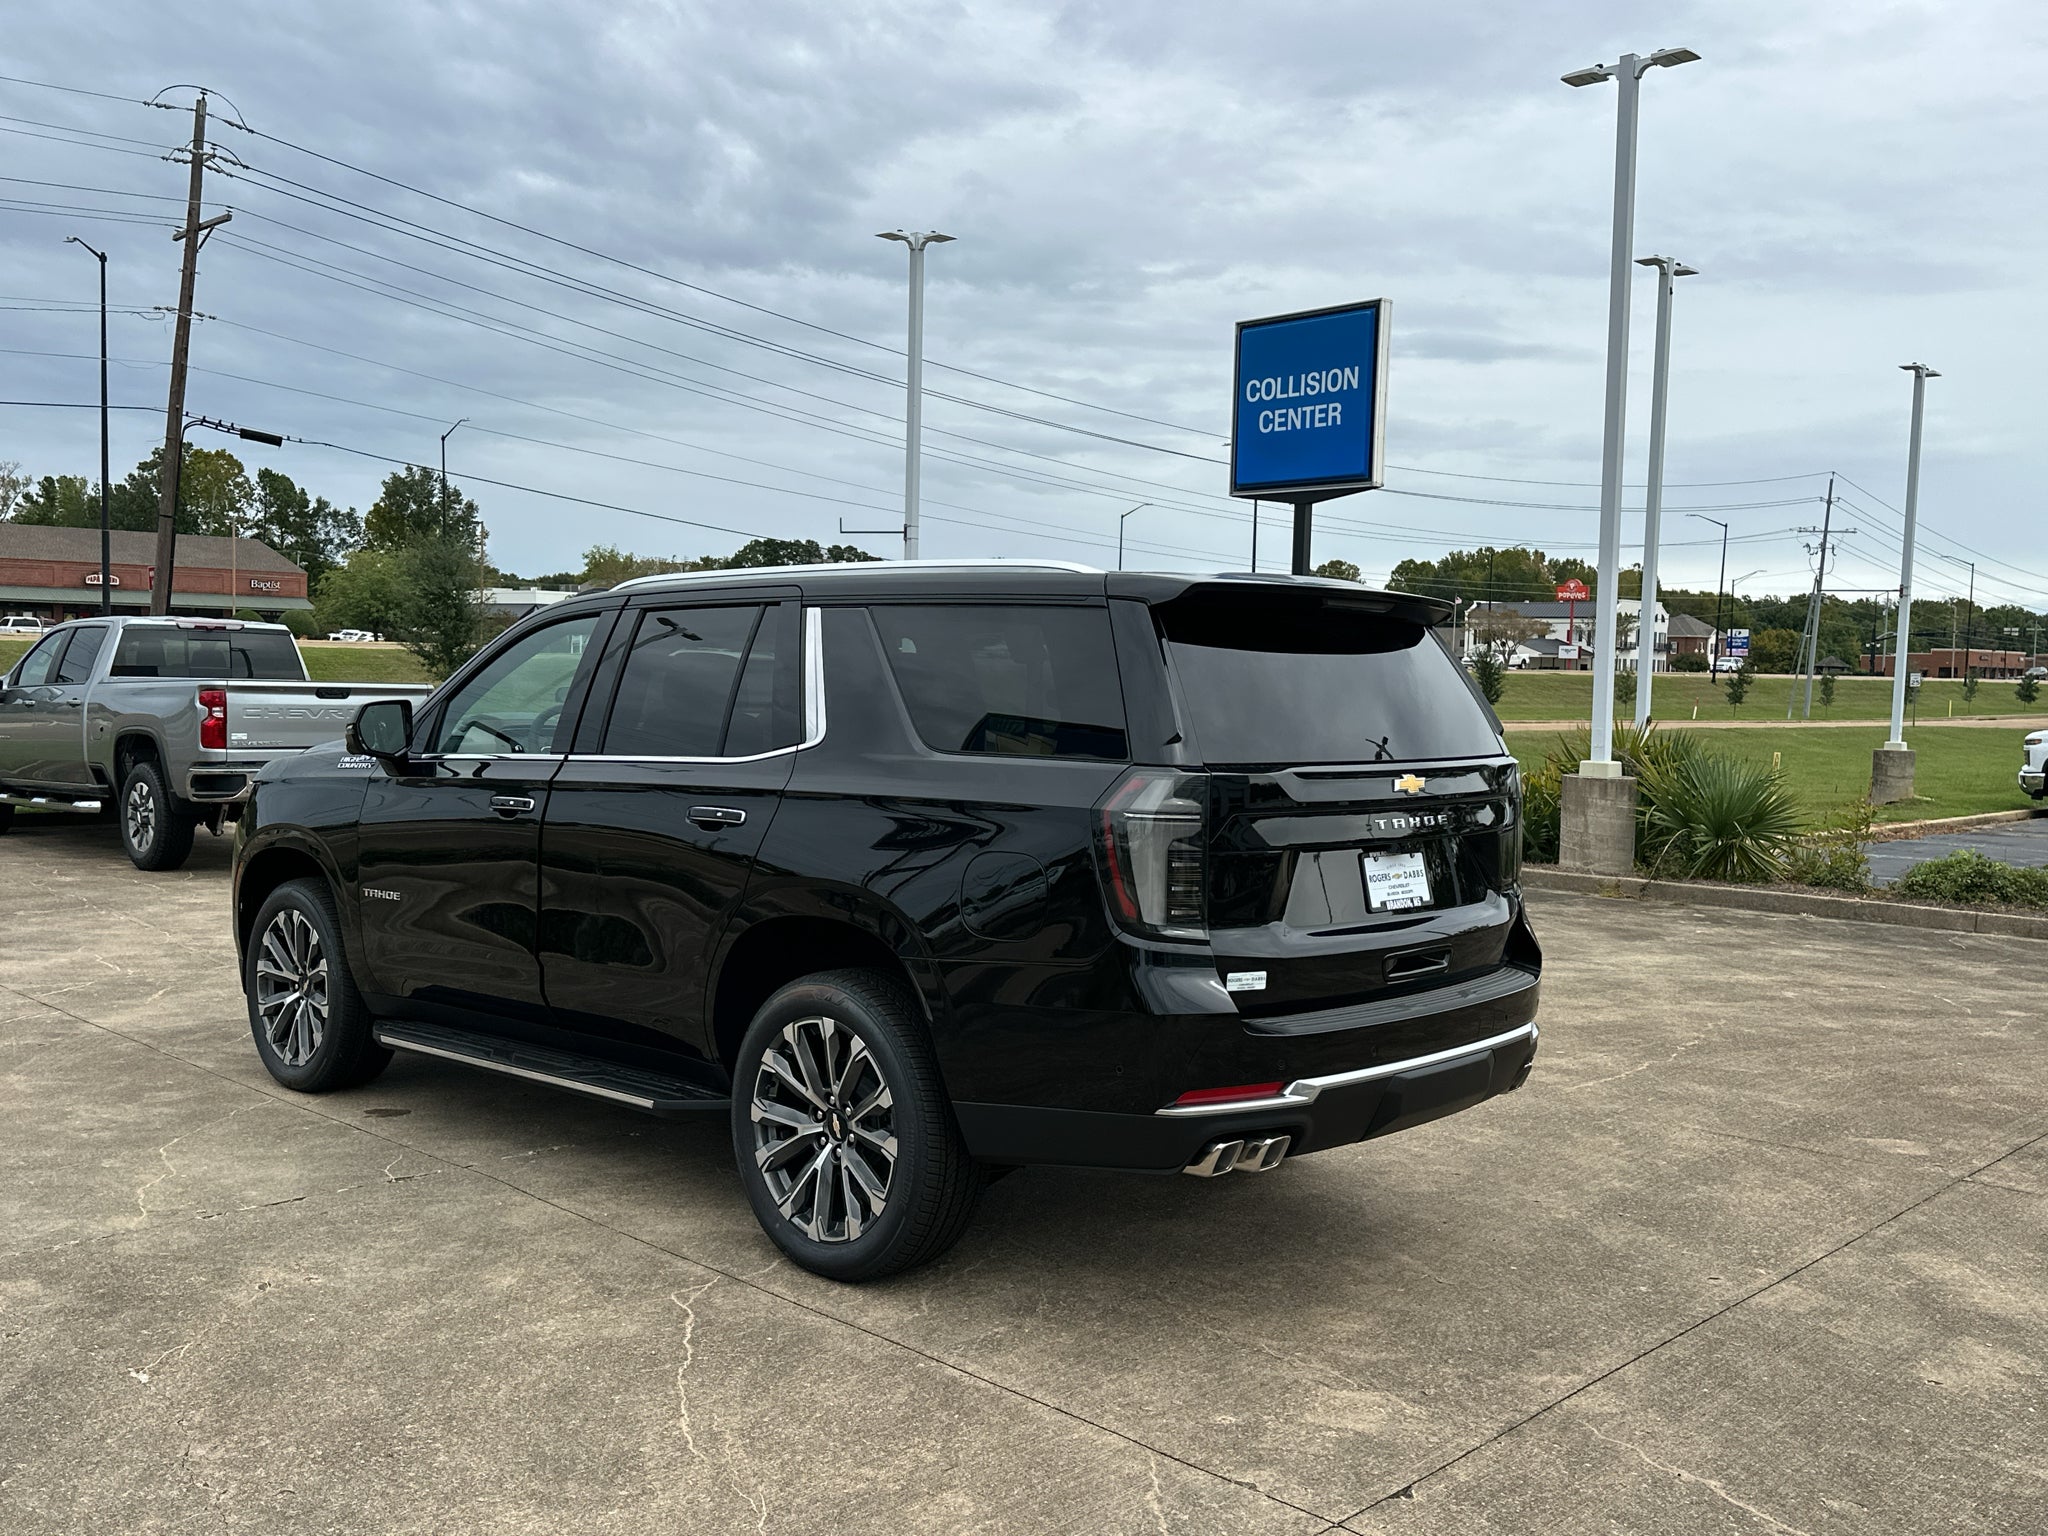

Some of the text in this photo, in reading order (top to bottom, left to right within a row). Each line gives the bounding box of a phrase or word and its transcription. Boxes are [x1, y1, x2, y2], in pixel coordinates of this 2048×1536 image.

[1246, 366, 1359, 402] COLLISION
[1258, 402, 1342, 434] CENTER
[251, 579, 280, 590] Baptist
[1374, 814, 1448, 830] TAHOE
[1369, 869, 1424, 883] ROGERS DABBS
[362, 887, 401, 901] TAHOE
